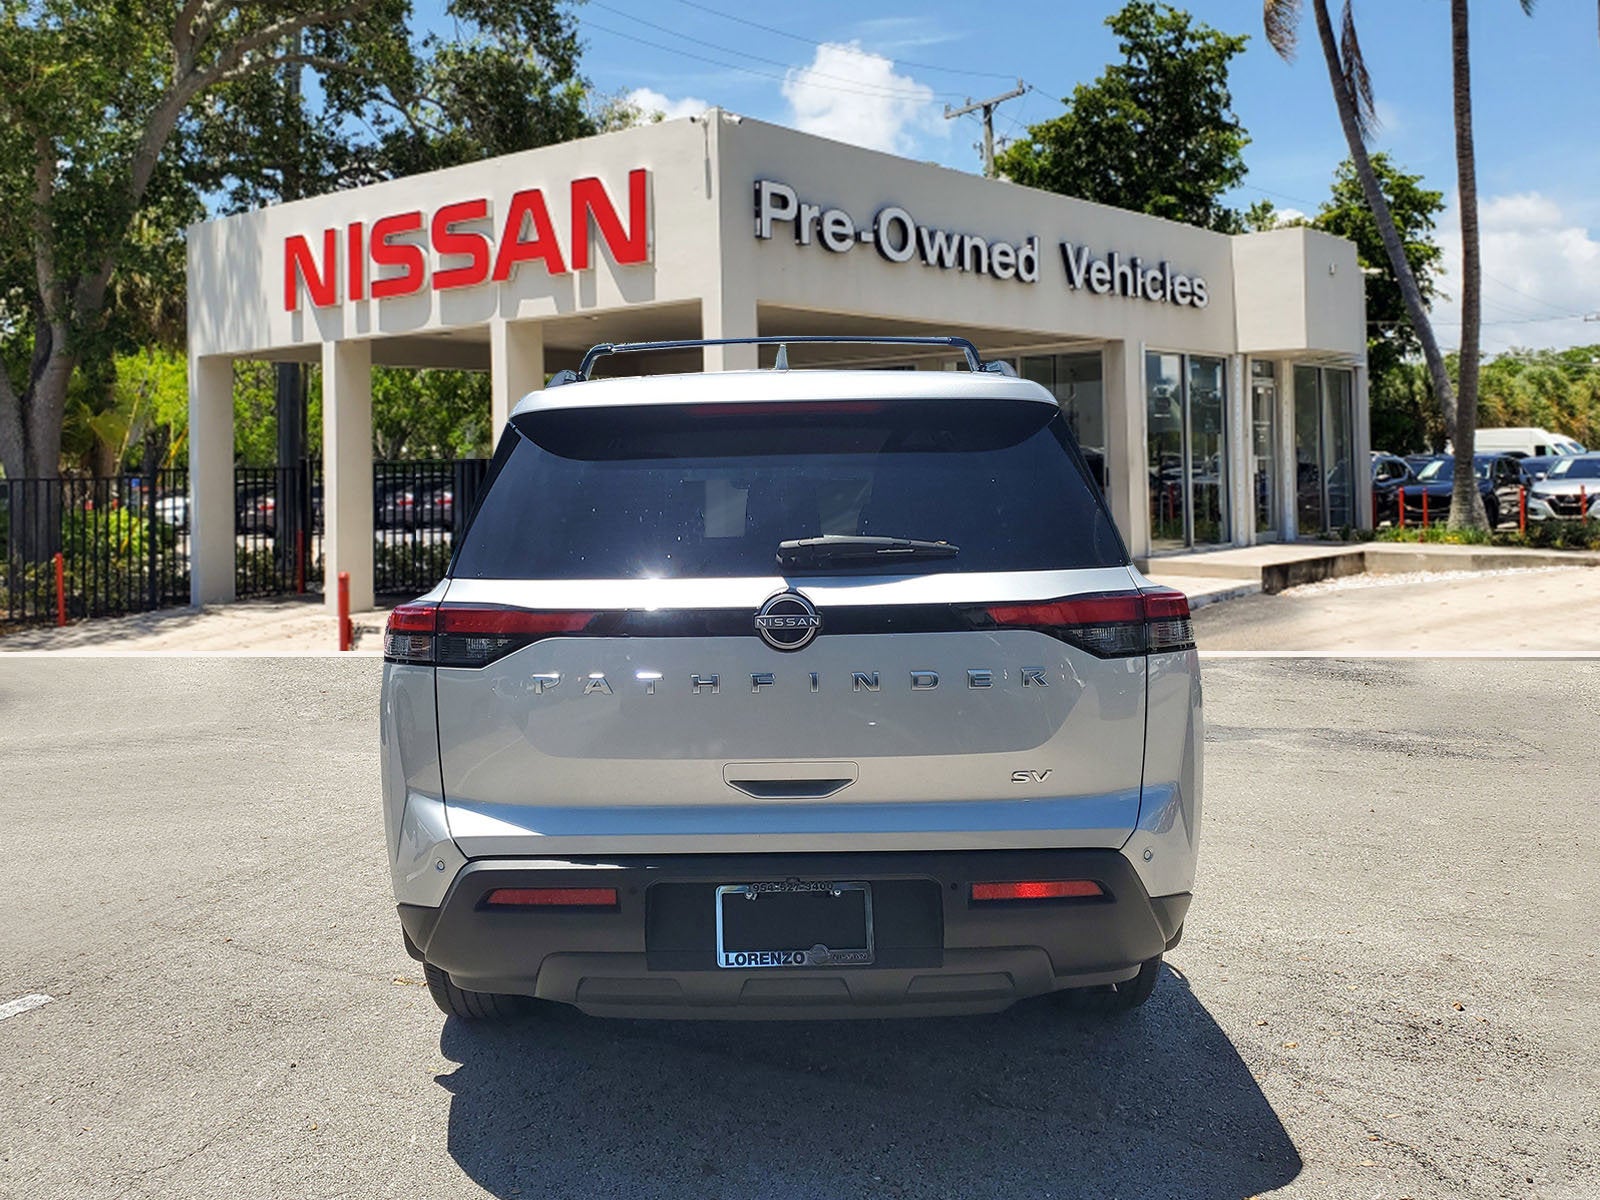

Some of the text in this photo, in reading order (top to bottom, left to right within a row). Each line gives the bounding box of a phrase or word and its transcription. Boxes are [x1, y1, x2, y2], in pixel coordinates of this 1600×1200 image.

[285, 168, 648, 313] NISSAN
[754, 180, 1208, 308] Pre-Owned Vehicles
[756, 617, 820, 627] NISSAN
[532, 666, 1049, 694] PATHFINDER
[1011, 769, 1052, 784] SV
[725, 953, 806, 965] LORENZO
